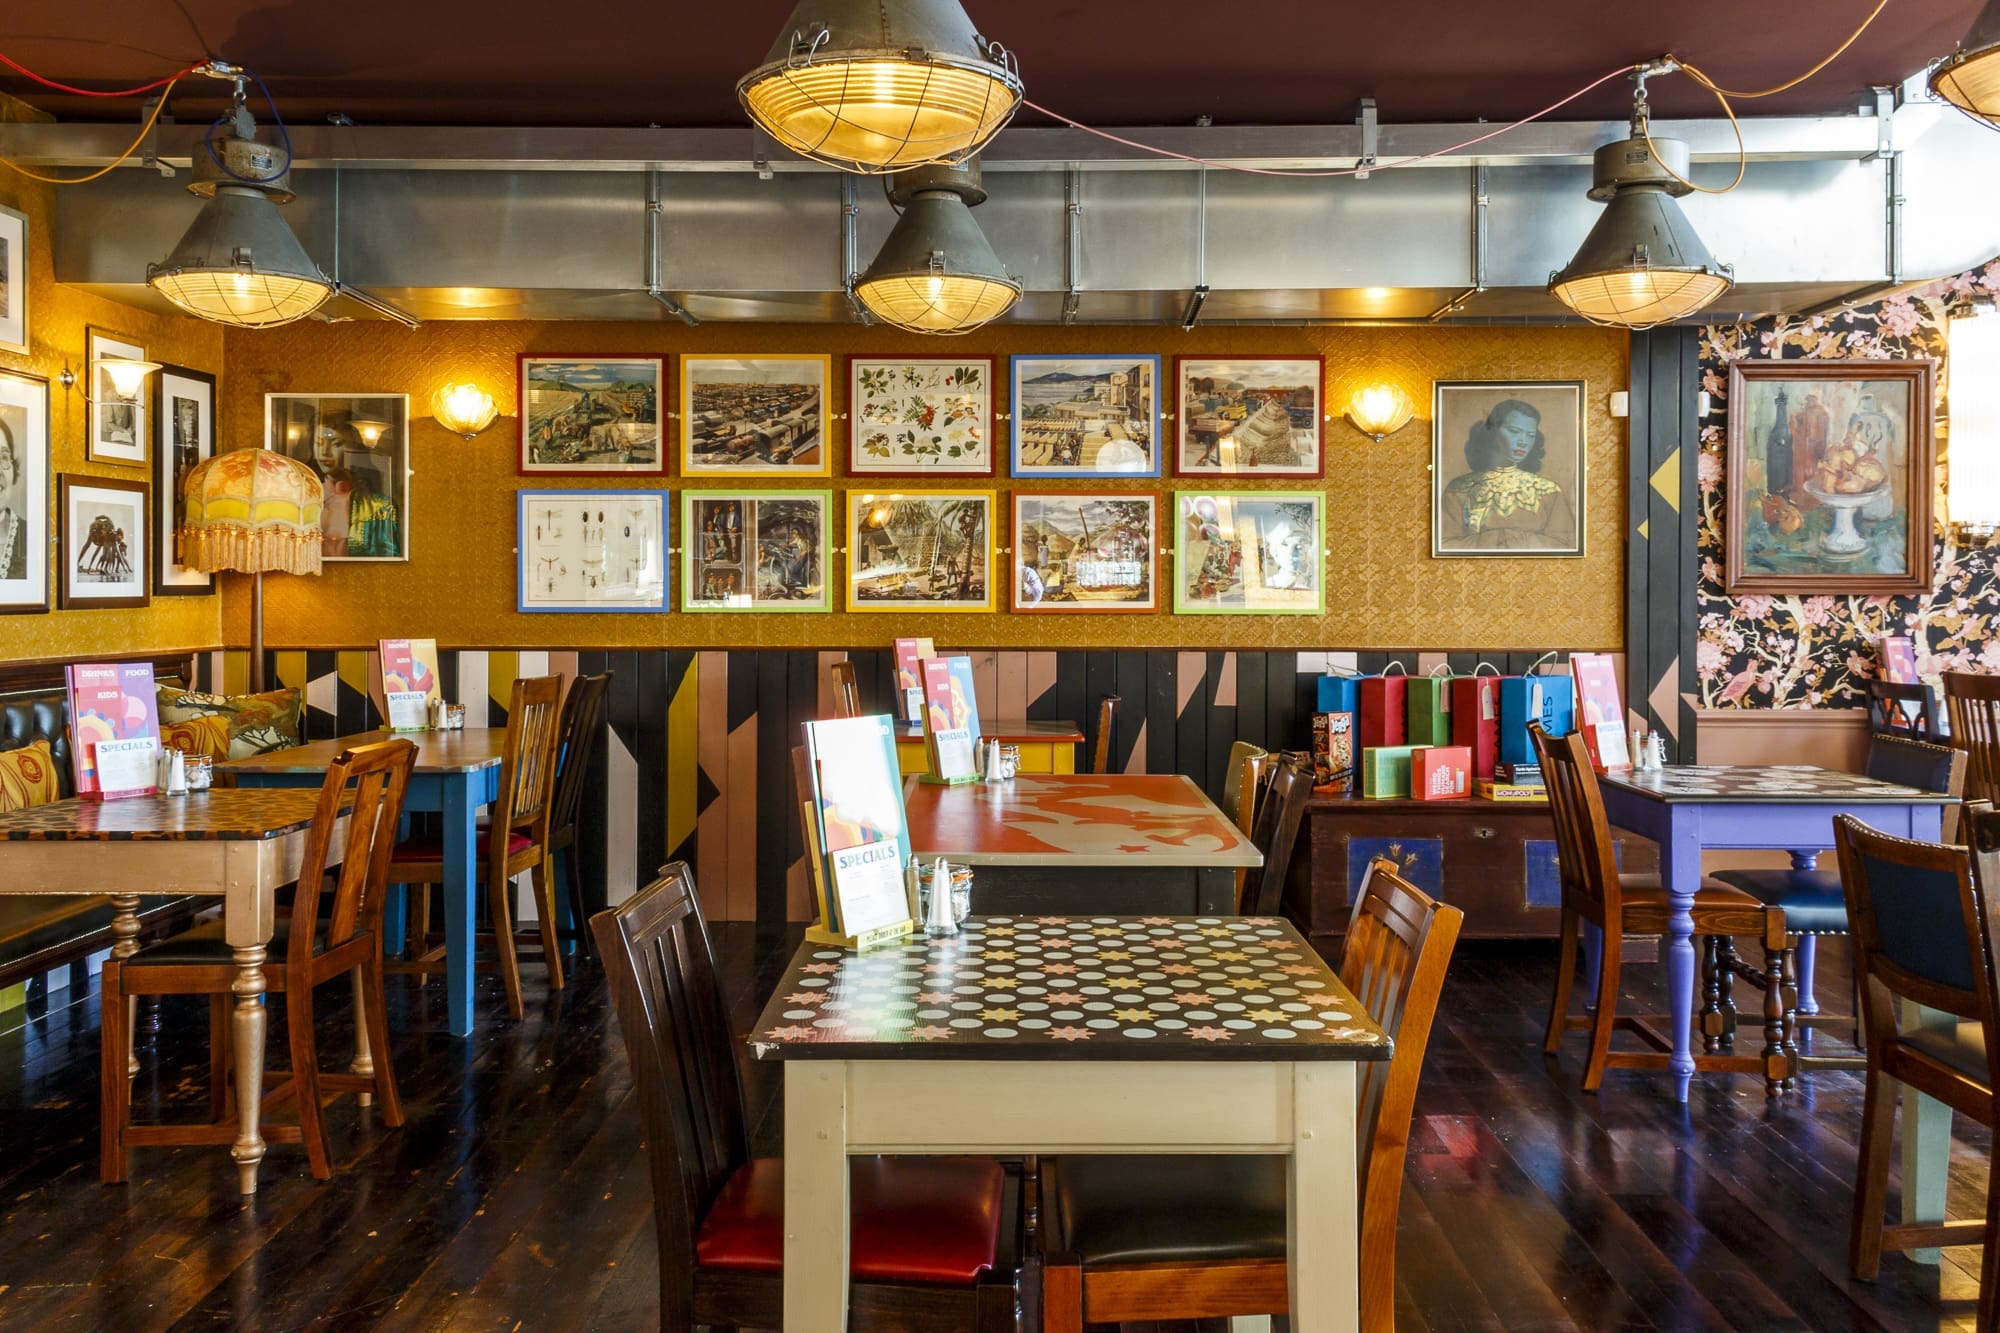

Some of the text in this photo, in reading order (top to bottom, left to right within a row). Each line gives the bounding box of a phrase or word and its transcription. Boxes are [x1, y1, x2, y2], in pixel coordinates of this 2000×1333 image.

[125, 669, 149, 677] FOOD
[939, 731, 969, 742] SPECIALS
[100, 741, 153, 753] SPECIALS
[840, 846, 896, 869] SPECIALS
